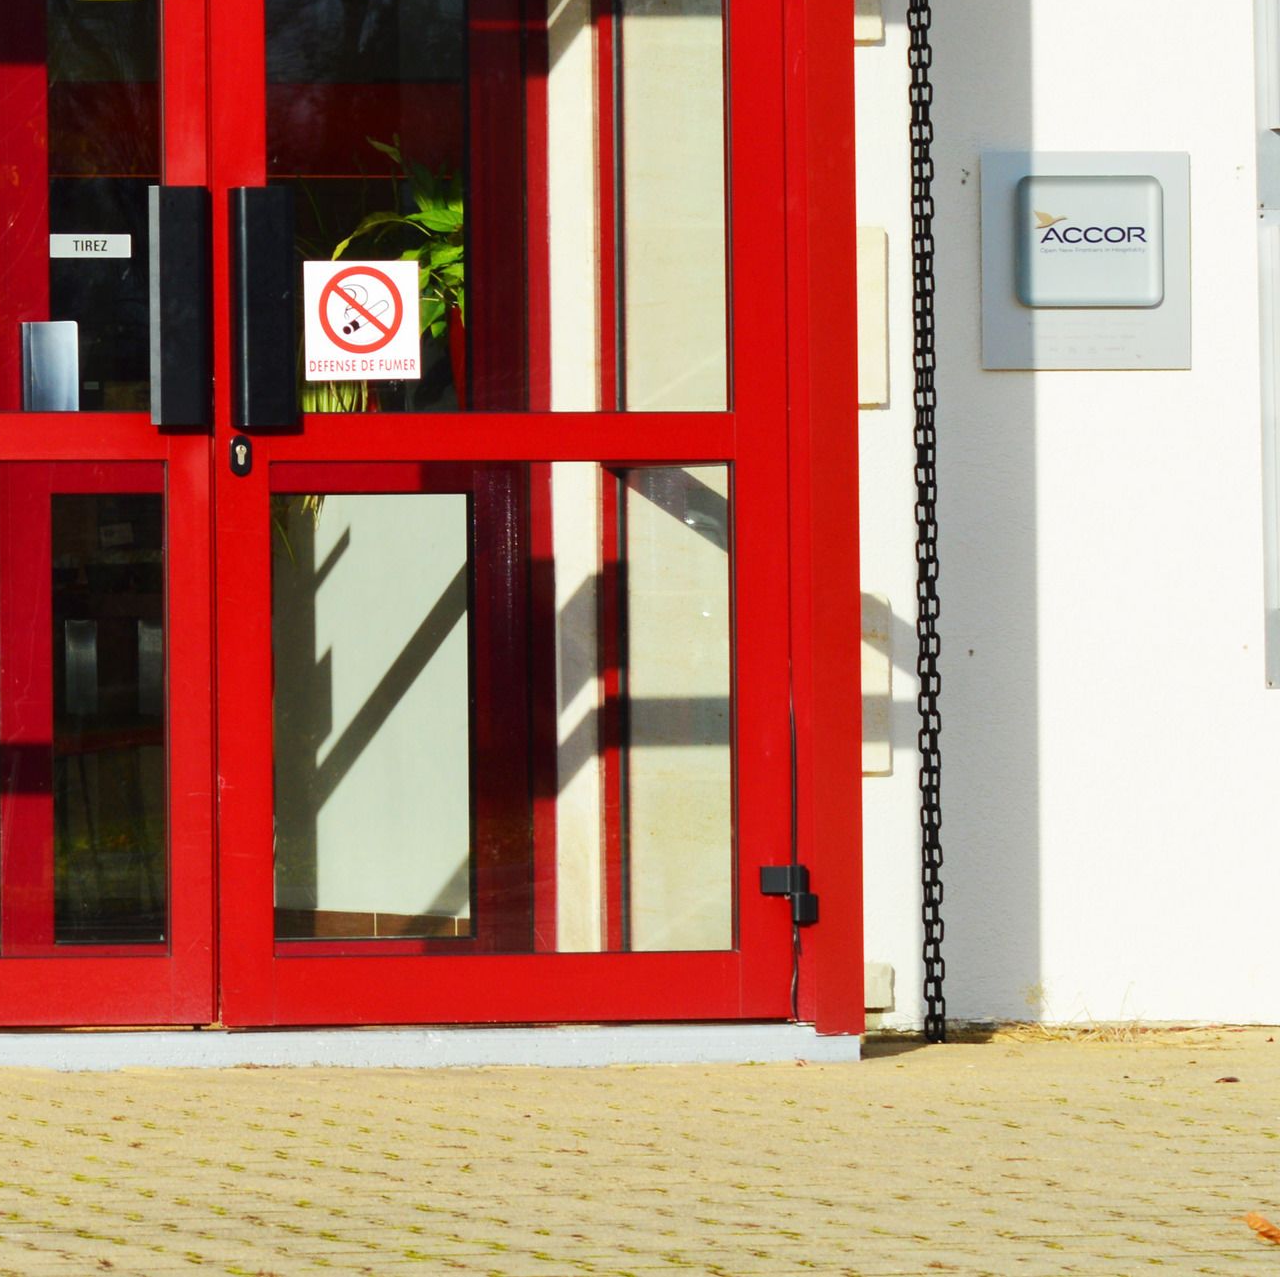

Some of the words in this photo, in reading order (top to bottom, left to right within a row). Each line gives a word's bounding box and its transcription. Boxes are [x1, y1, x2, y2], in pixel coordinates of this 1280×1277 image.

[1040, 226, 1147, 244] ACCOR
[72, 239, 108, 252] TIREZ
[361, 359, 375, 372] DE
[379, 358, 416, 371] FUMER
